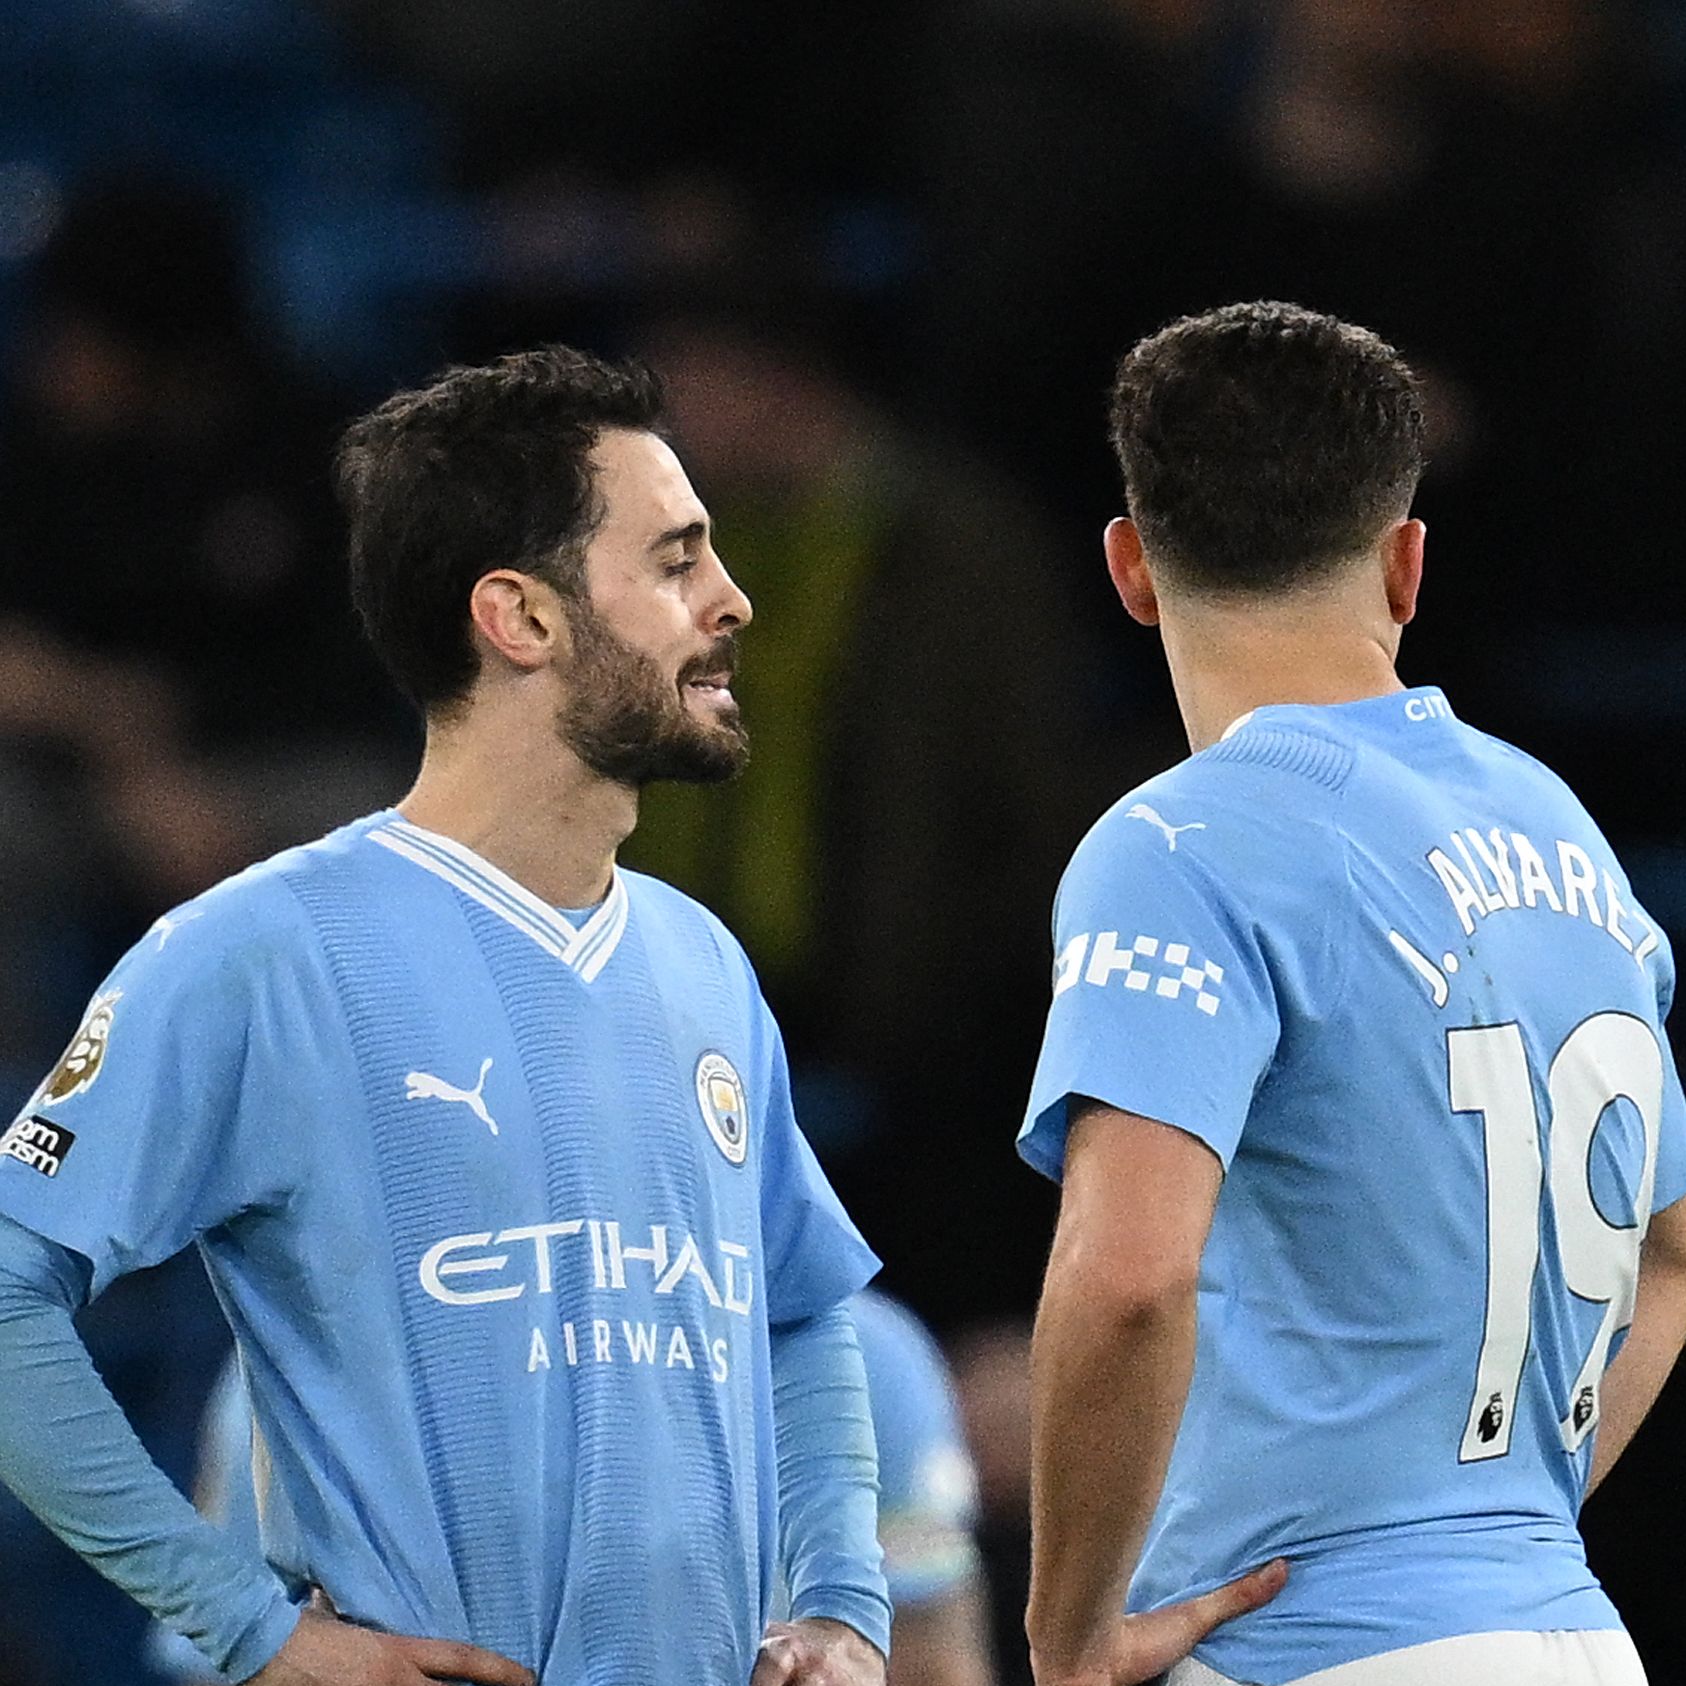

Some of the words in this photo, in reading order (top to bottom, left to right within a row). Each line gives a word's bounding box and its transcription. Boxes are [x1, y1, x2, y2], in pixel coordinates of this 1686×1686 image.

[1388, 927, 1459, 1009] J.
[419, 1218, 752, 1316] ETIHAD
[1446, 1010, 1664, 1466] 19
